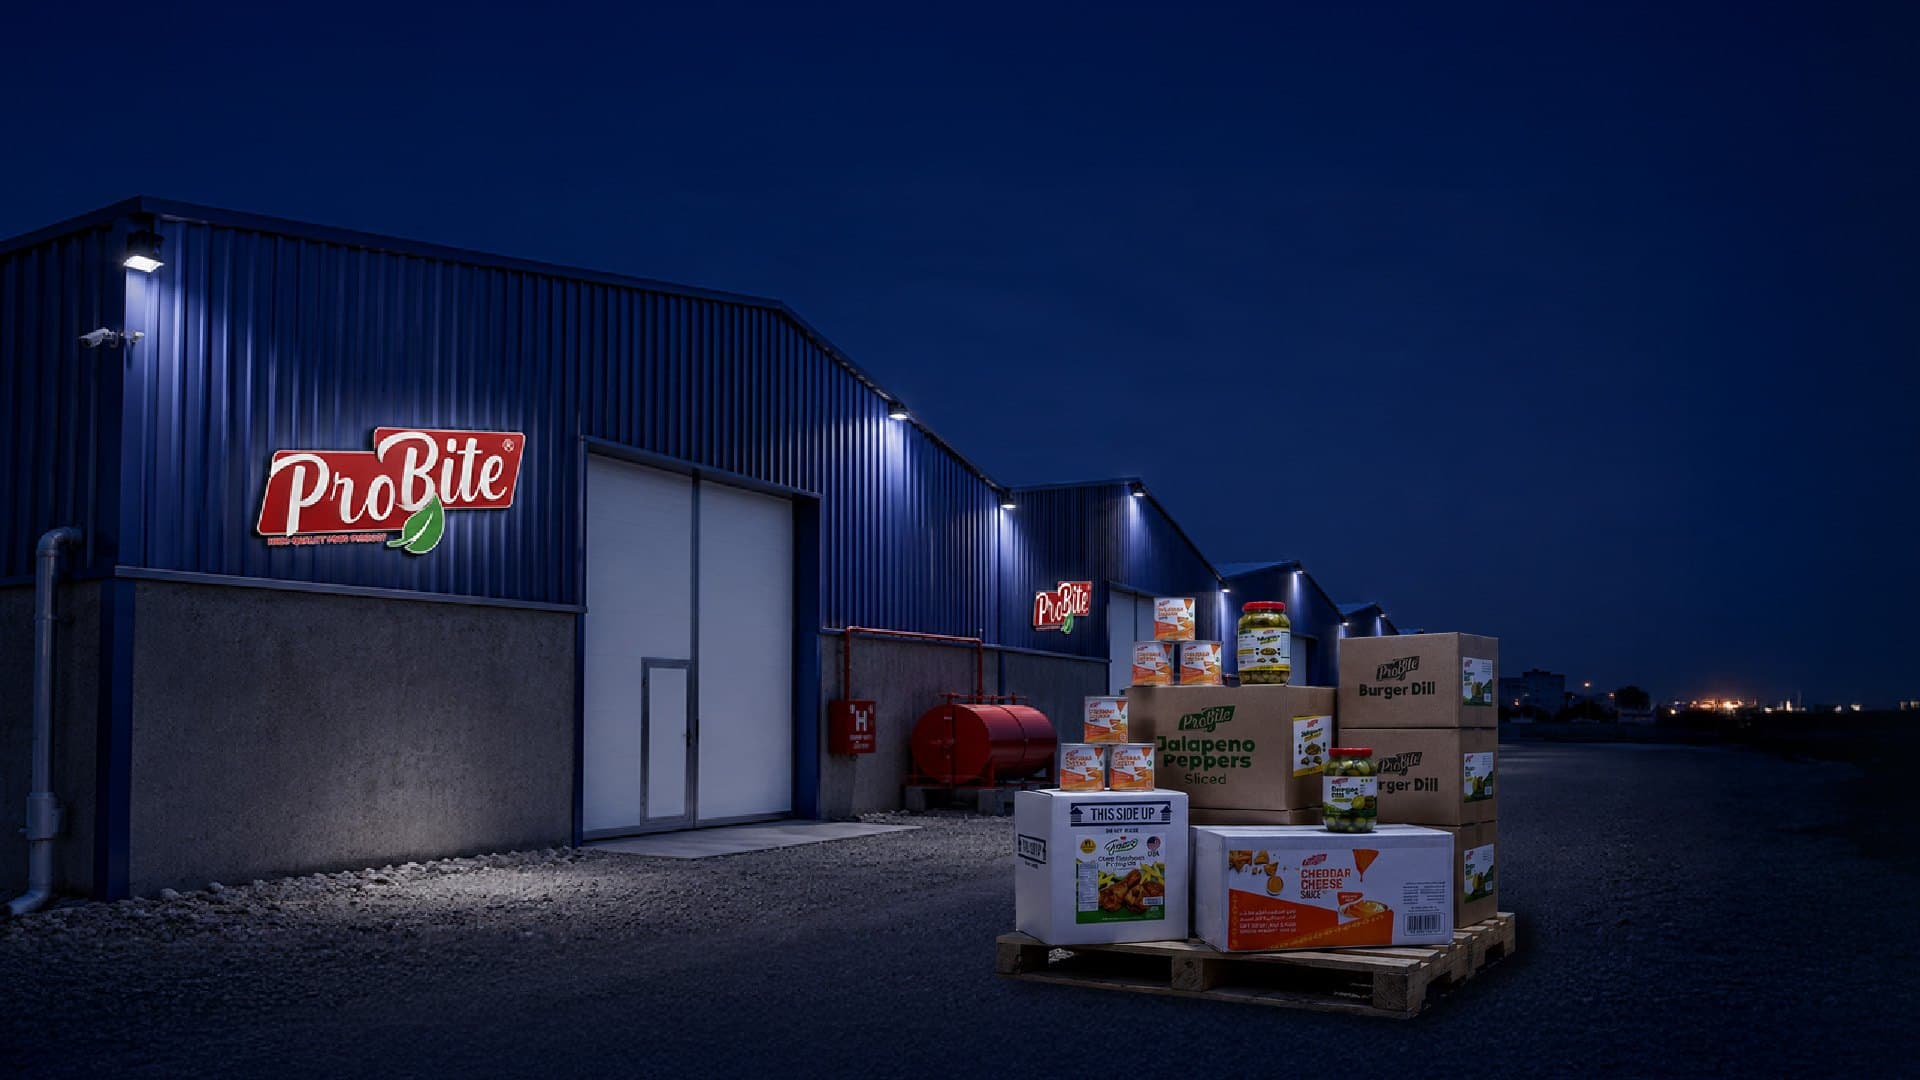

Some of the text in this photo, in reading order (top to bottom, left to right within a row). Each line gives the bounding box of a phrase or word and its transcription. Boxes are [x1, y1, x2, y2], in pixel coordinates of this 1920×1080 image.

[272, 431, 508, 537] ProBite
[1036, 583, 1089, 626] ProBite
[1359, 681, 1436, 700] Burger Dill
[1156, 735, 1256, 755] Jalapeno
[1163, 753, 1252, 772] Peppers
[1184, 773, 1227, 785] Sliced
[1378, 780, 1411, 794] rger
[1414, 777, 1439, 792] Dill
[1090, 807, 1155, 821] THIS SIDE UP
[1300, 868, 1351, 879] CHEDDAR
[1300, 879, 1344, 890] CHEESE
[1300, 890, 1321, 900] SAUCE
